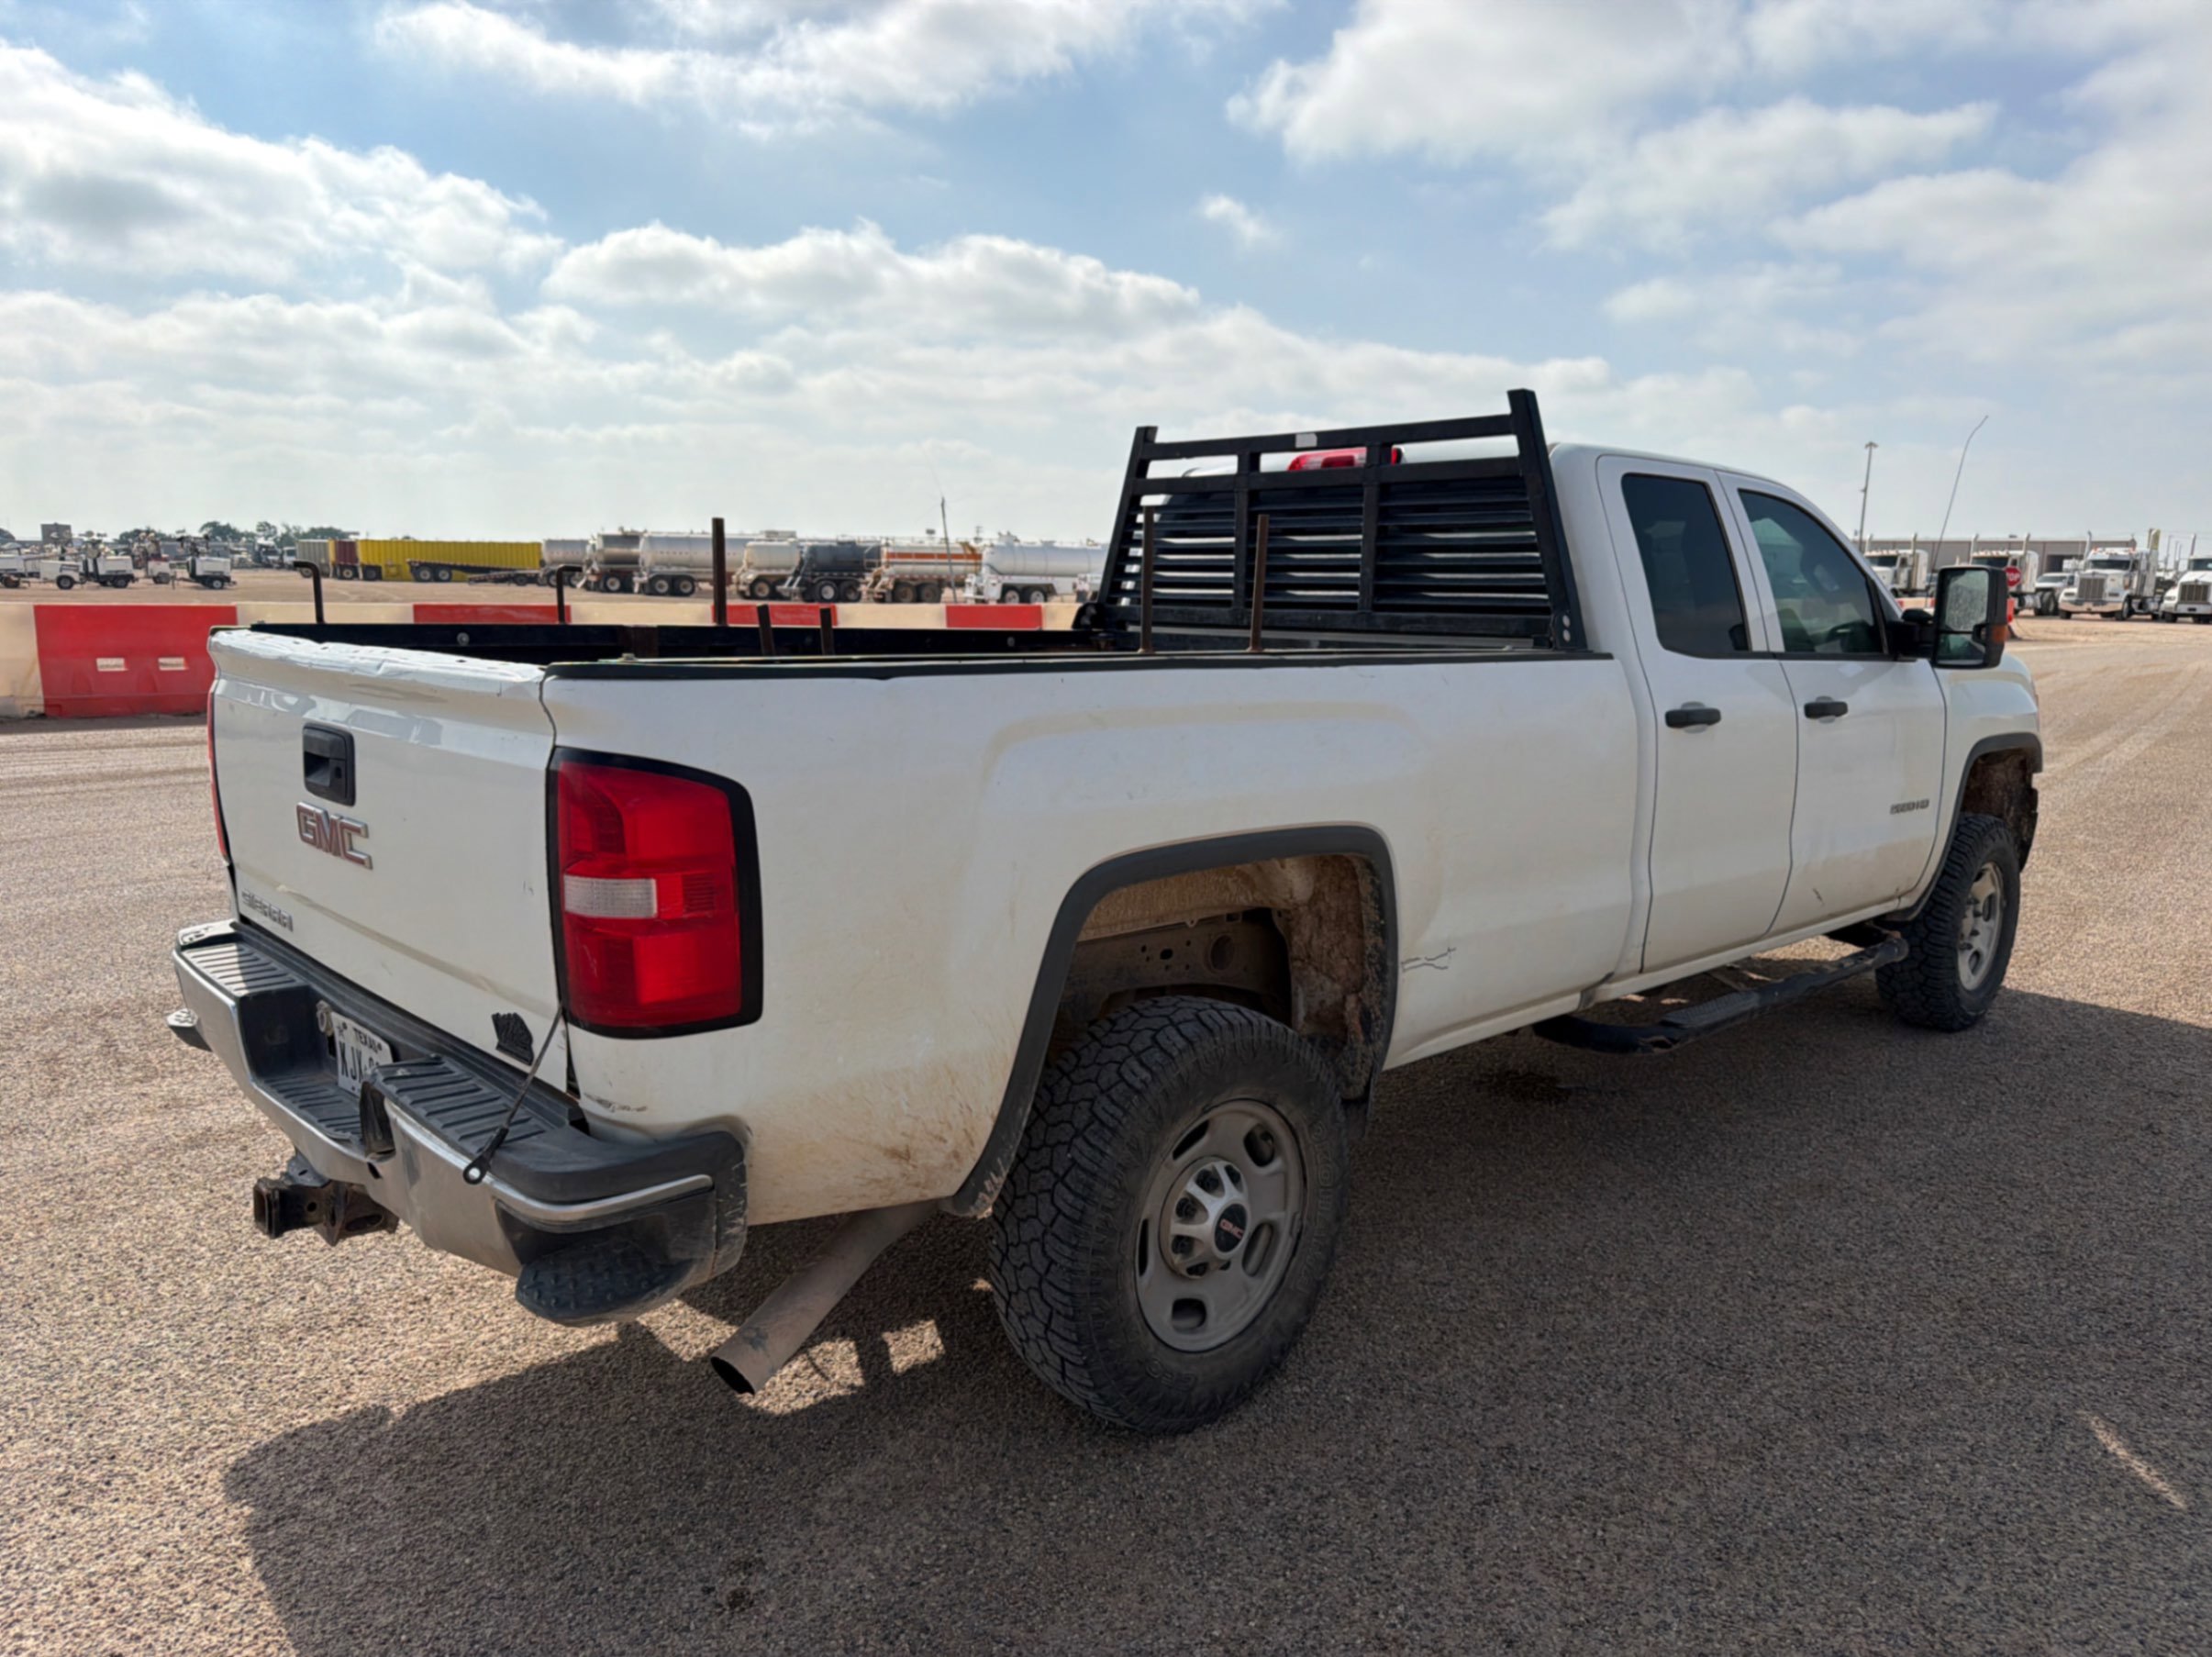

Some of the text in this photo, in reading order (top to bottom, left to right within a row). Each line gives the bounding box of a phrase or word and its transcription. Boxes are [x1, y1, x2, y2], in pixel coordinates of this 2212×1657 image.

[296, 801, 373, 870] GMC
[352, 1027, 378, 1053] TEXAS
[1219, 1218, 1244, 1240] GMC
